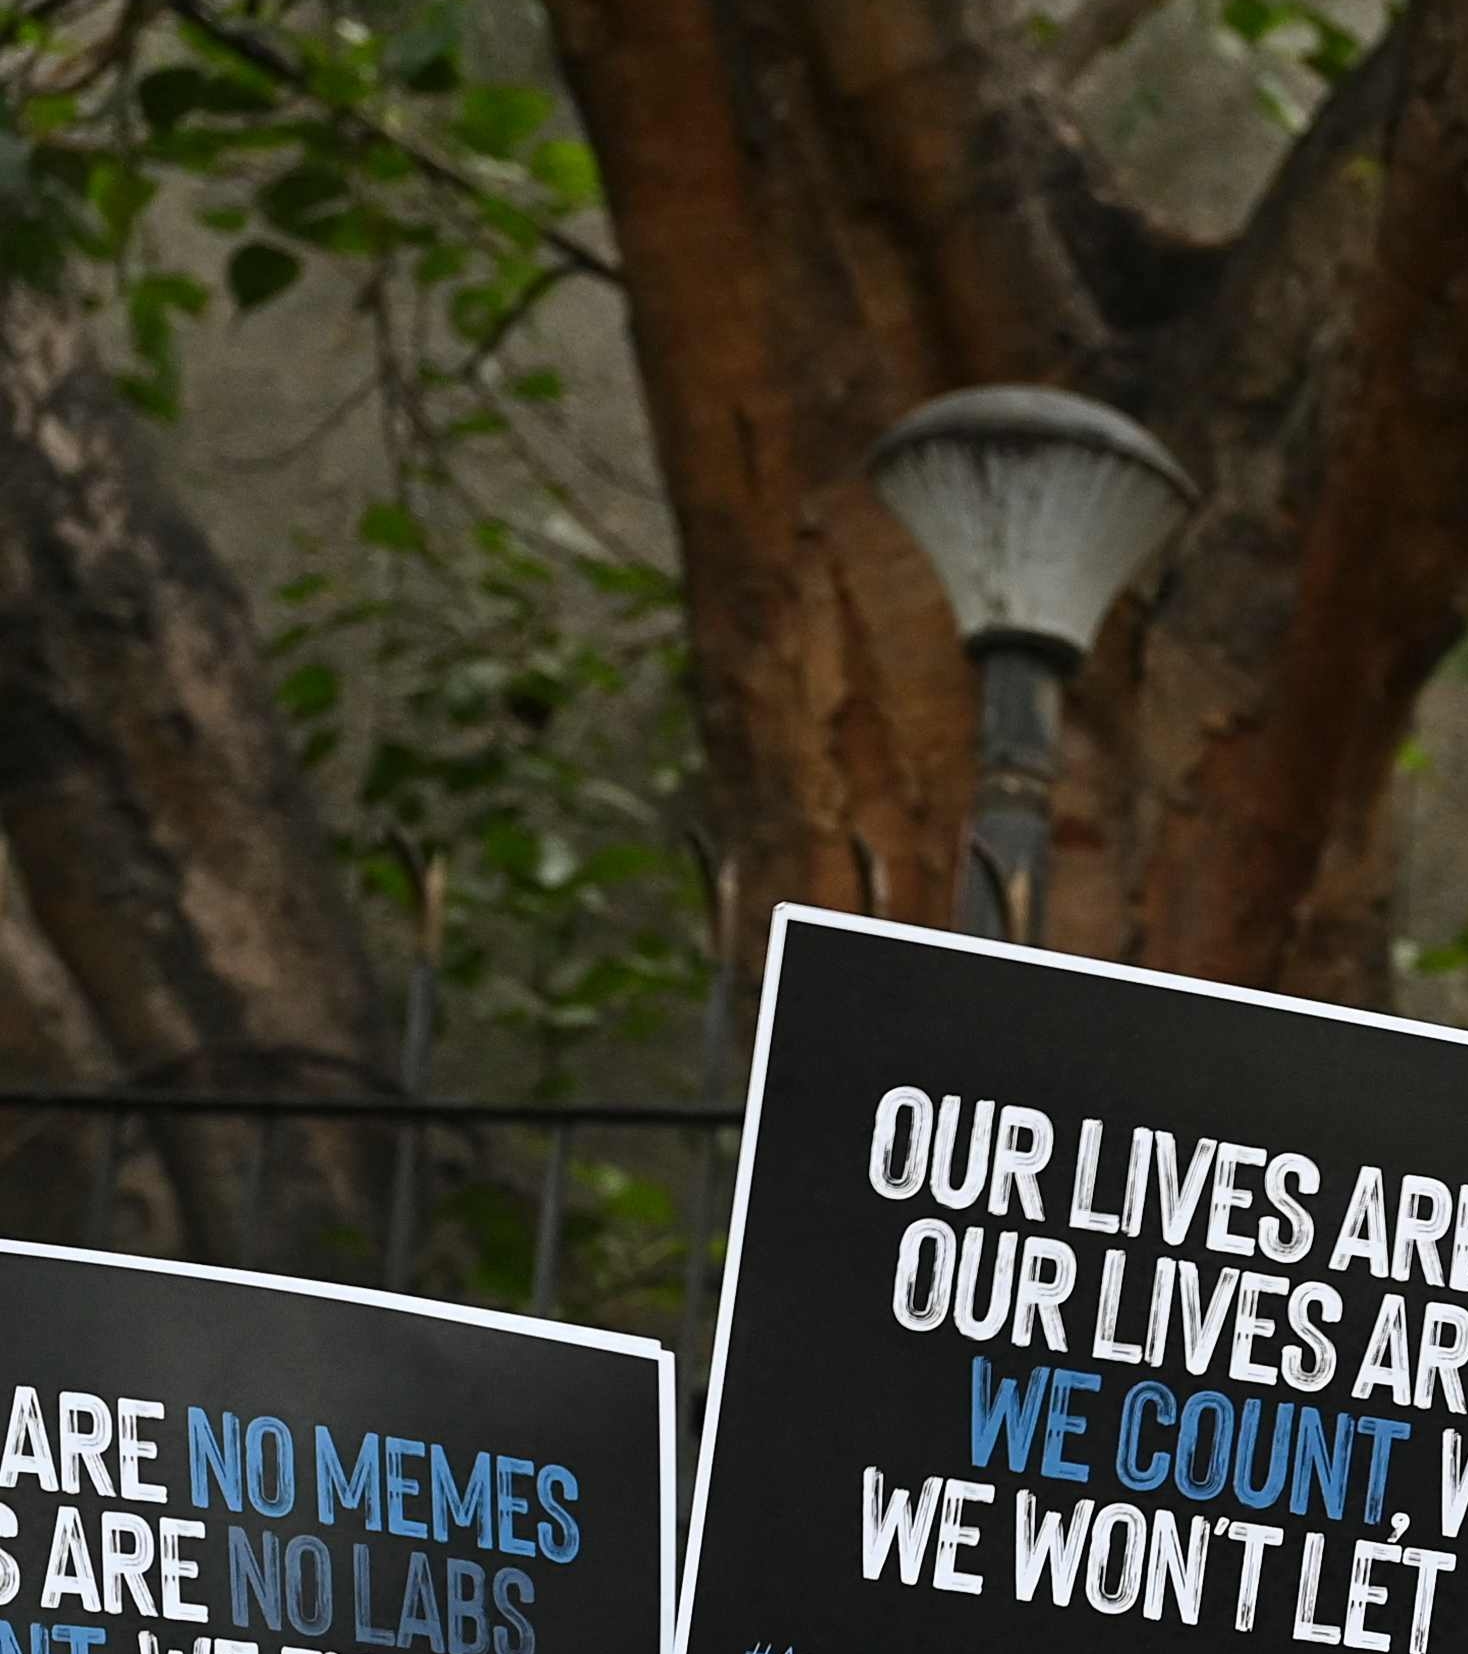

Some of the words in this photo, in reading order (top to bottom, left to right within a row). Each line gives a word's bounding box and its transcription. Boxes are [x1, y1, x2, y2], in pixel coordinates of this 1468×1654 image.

[869, 1085, 1054, 1222] OUR
[1068, 1118, 1321, 1263] LIVES
[892, 1218, 1078, 1353] OUR
[1091, 1248, 1343, 1393] LIVES
[0, 1384, 168, 1504] ARE
[187, 1406, 295, 1518] NO
[314, 1423, 581, 1565] MEMES
[969, 1355, 1103, 1484] WE
[1115, 1378, 1412, 1542] COUNT,
[40, 1506, 209, 1624] ARE
[227, 1526, 333, 1638] NO
[862, 1465, 996, 1596] WE
[1013, 1488, 1285, 1633] WON'T
